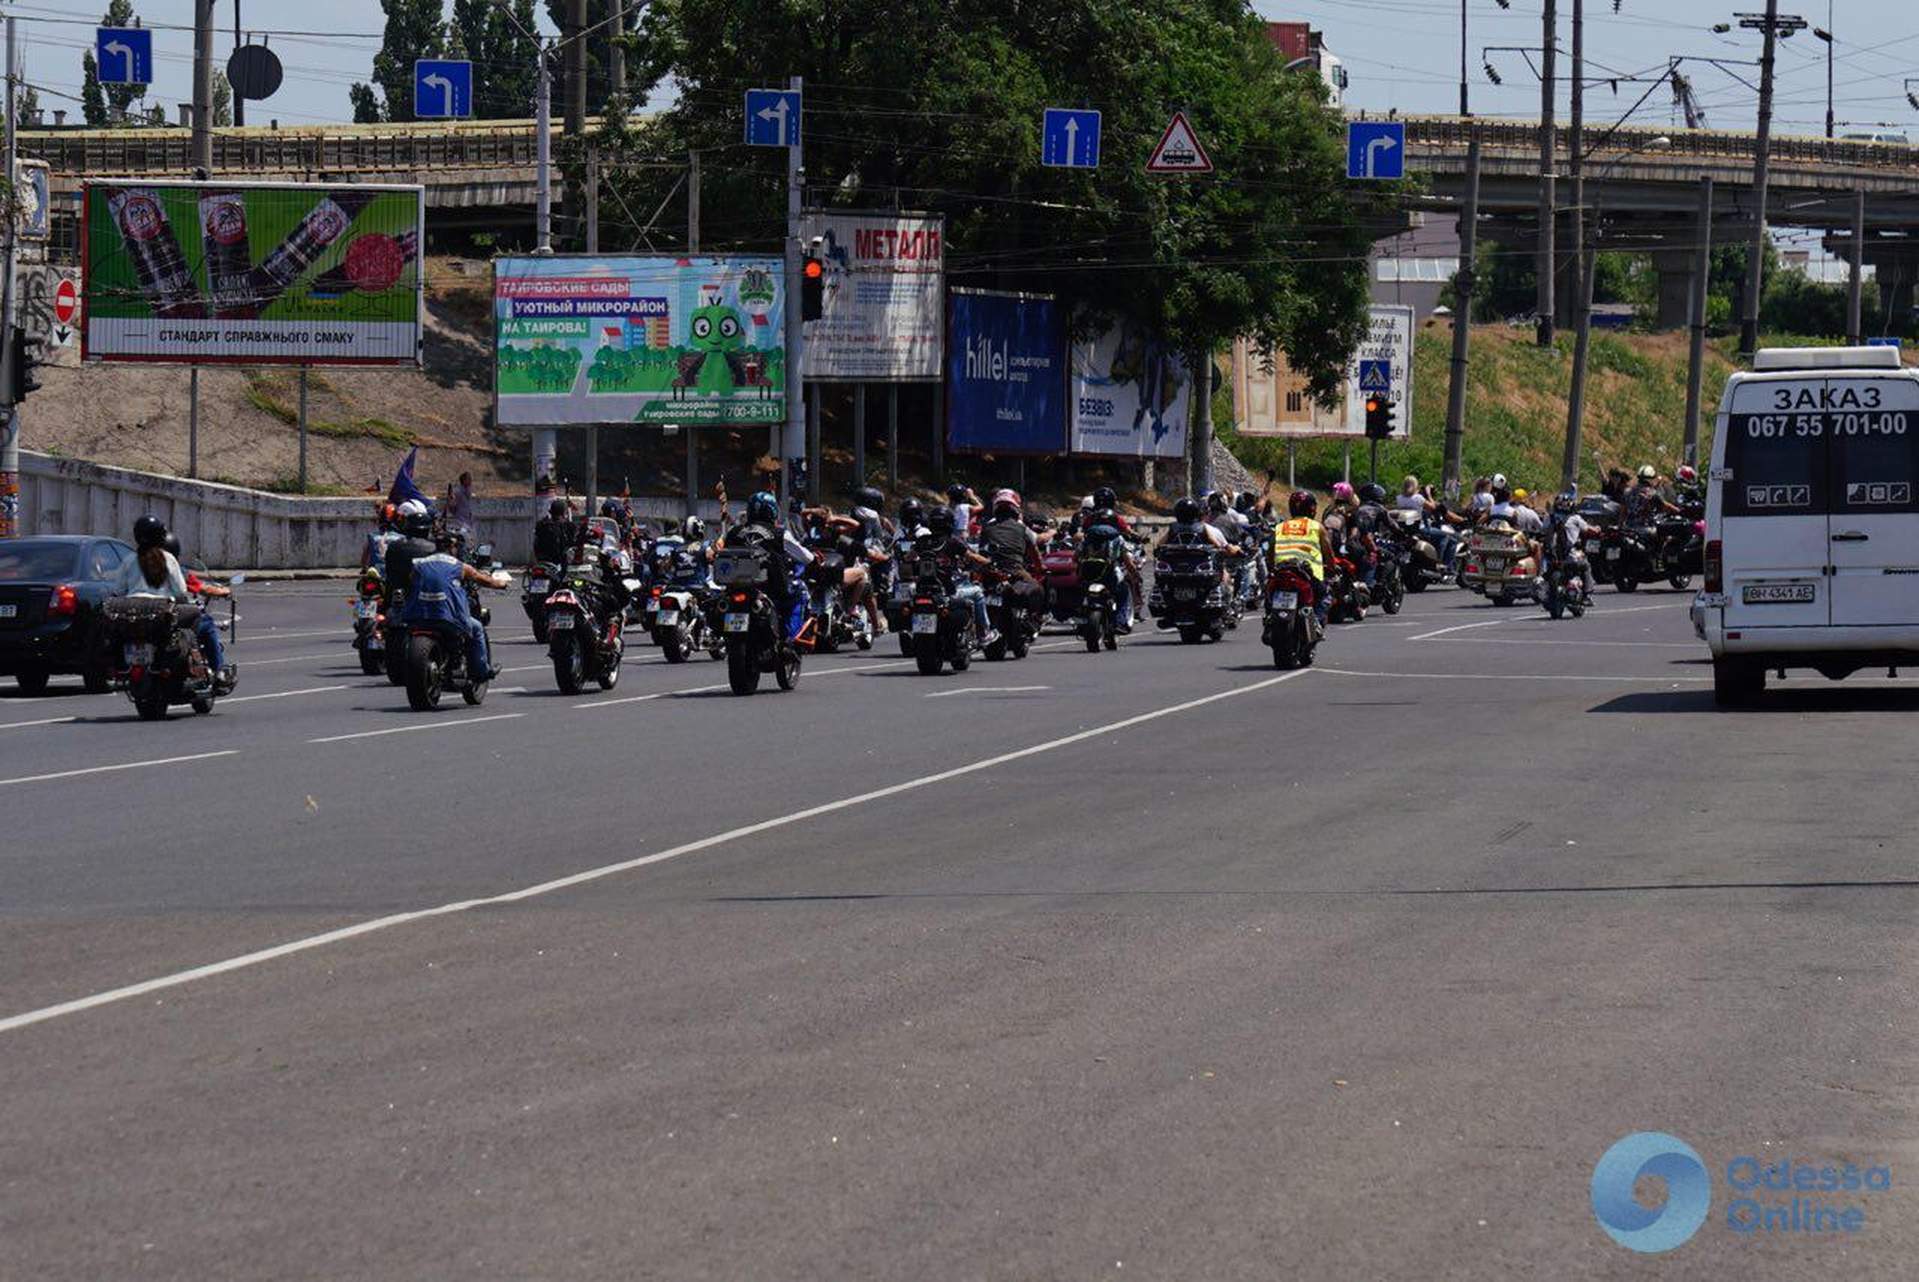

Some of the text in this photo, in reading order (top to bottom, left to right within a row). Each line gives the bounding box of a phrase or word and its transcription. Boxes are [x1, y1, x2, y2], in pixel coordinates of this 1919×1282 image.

[591, 282, 629, 295] САДЫ
[514, 300, 666, 313] УЮТНЫЙ МИКРОРАЙОН
[502, 322, 587, 333] НА ТАИРОВА!
[159, 330, 355, 344] СТАНДАРТ СПРАВЖНЬОГО СМАКУ
[966, 333, 1008, 381] hillel
[1773, 387, 1882, 410] ЗАКАЗ
[1747, 413, 1907, 437] 067 55 701-00
